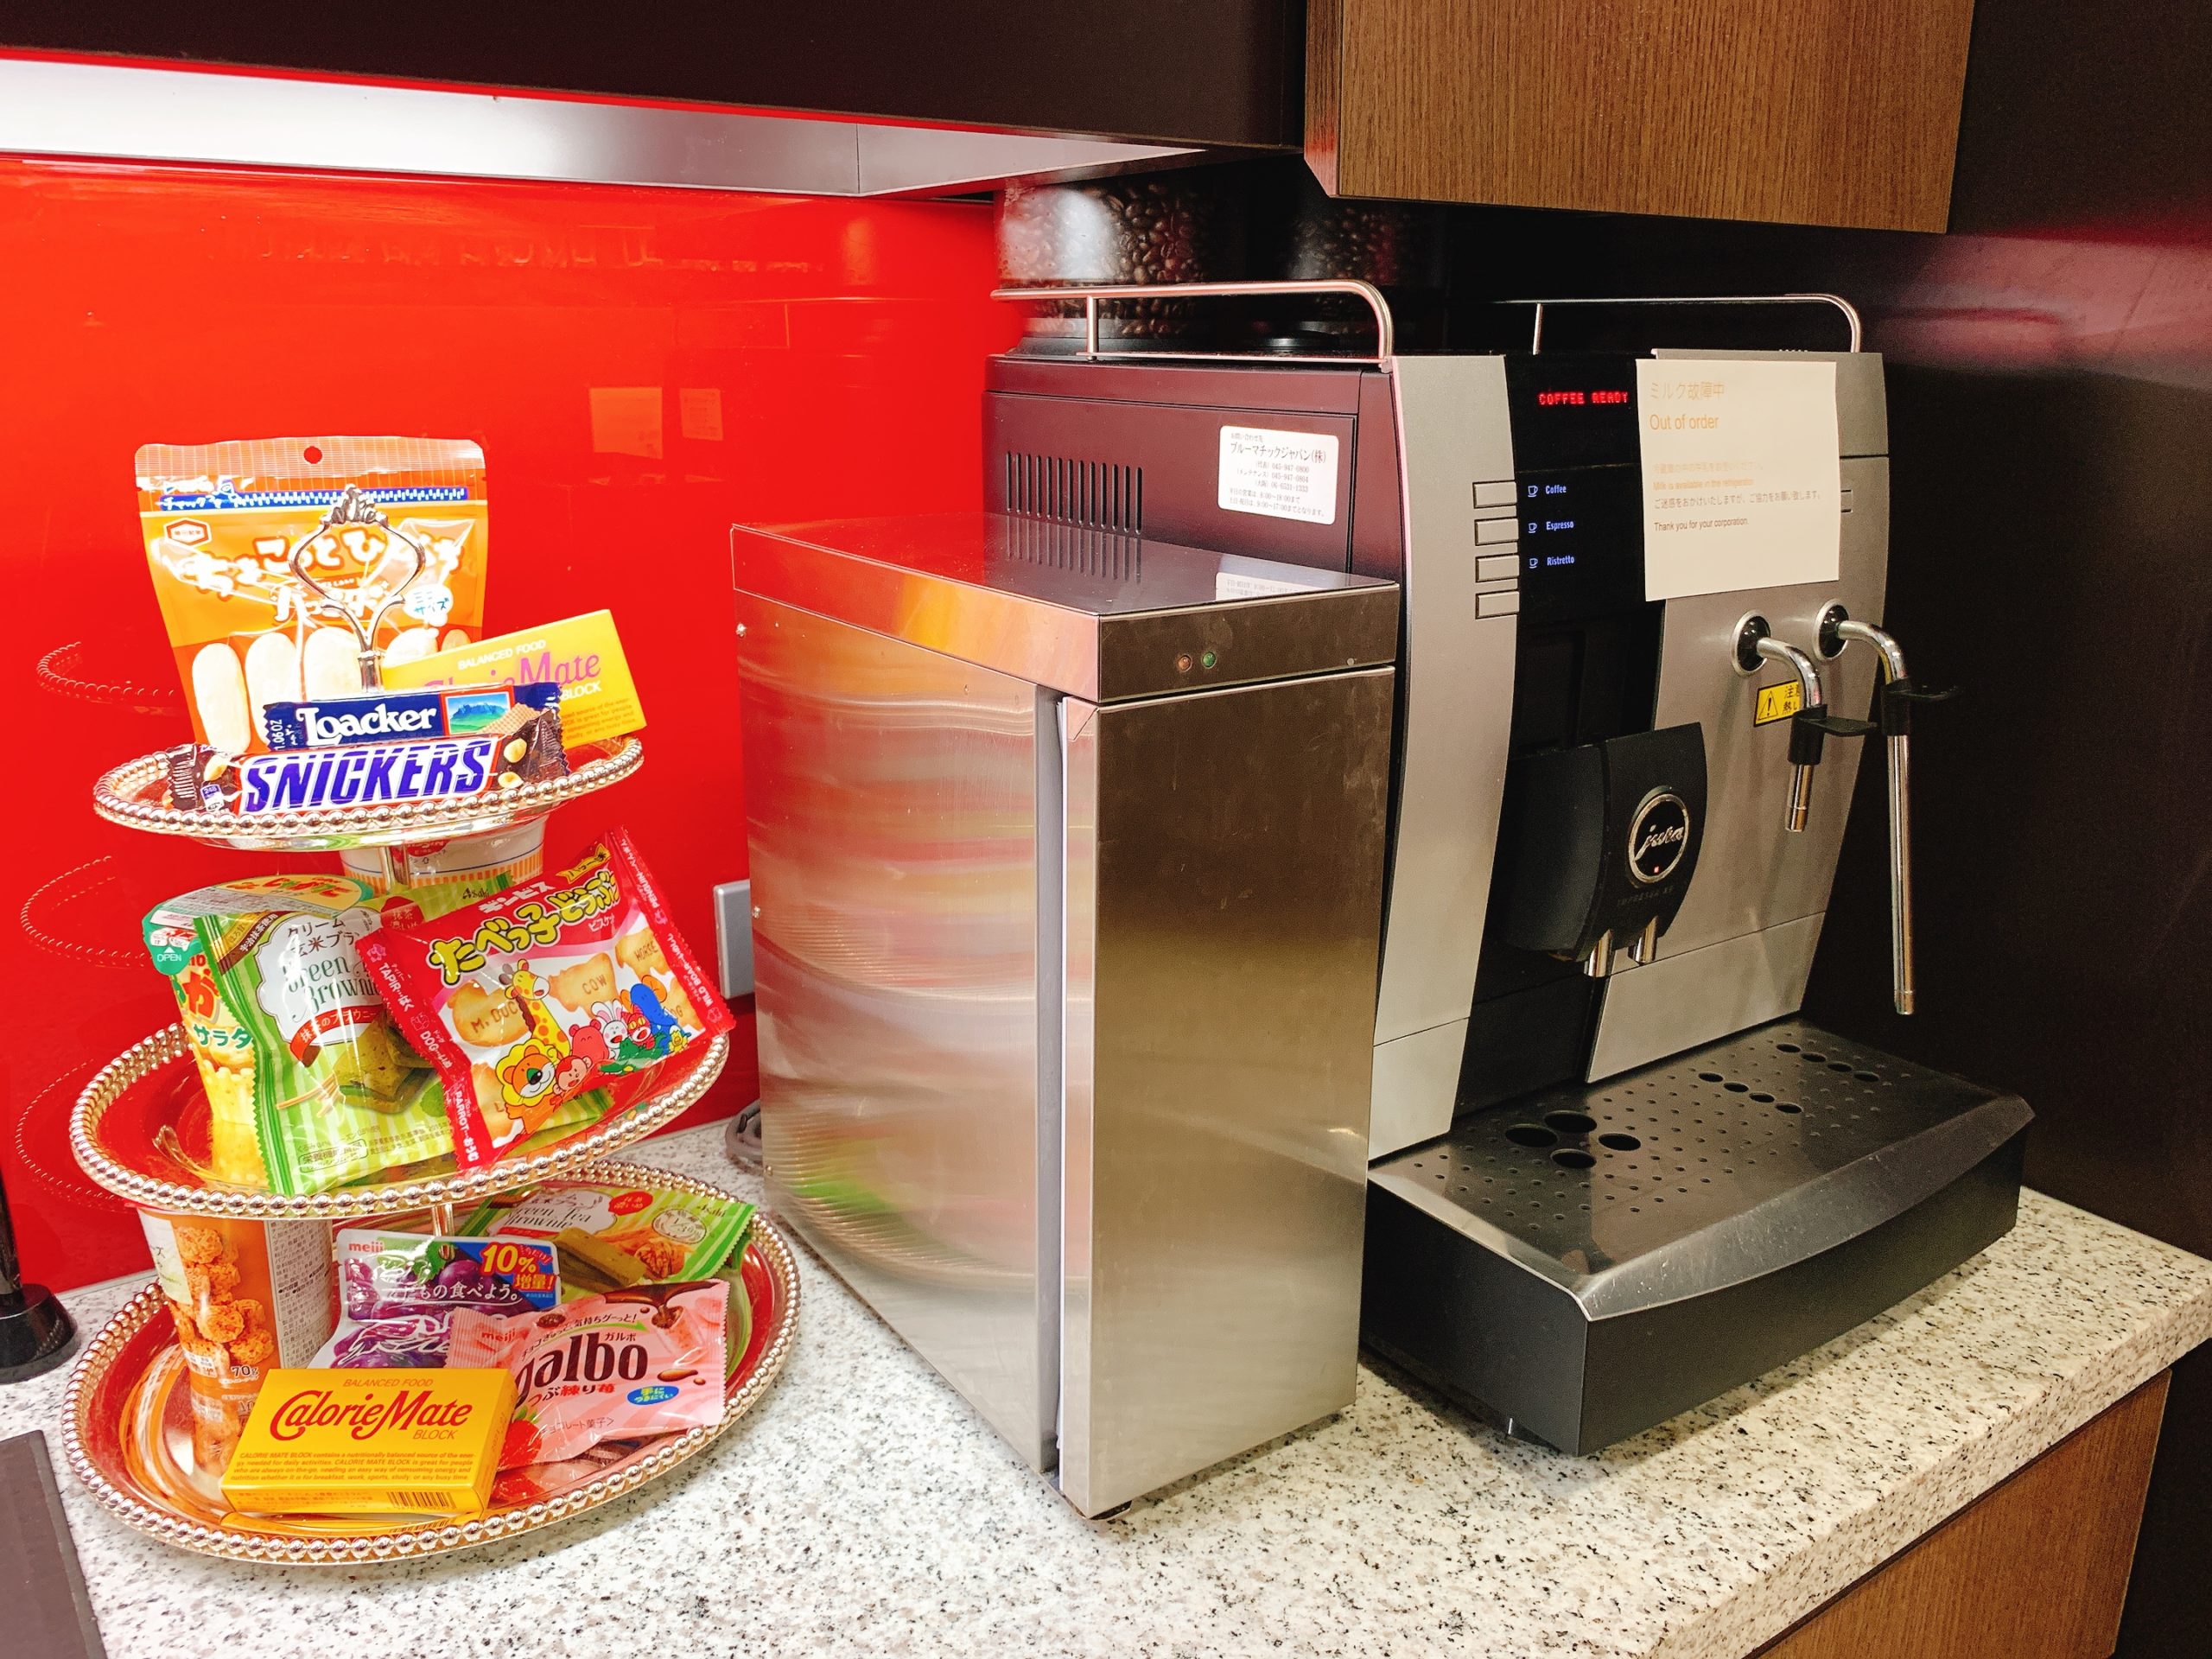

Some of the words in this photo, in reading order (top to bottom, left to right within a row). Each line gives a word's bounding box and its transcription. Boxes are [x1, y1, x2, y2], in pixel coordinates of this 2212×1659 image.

[1538, 391, 1585, 406] COFFEE
[1591, 391, 1629, 404] READY
[1649, 381, 1725, 401] ミルク故障中
[1649, 414, 1671, 430] Out
[1674, 413, 1686, 429] of
[1688, 414, 1719, 429] order
[1545, 485, 1567, 494] Coffee
[1546, 521, 1574, 531] Espresso
[1654, 522, 1674, 532] Thank
[1675, 522, 1688, 532] you
[1688, 520, 1698, 530] for
[1699, 520, 1713, 531] your
[1547, 555, 1575, 566] Ristretto
[457, 648, 512, 671] BALANCED
[516, 639, 546, 655] FOOD
[560, 680, 603, 702] BLOCK
[296, 702, 438, 749] Loacker
[245, 740, 493, 813] SNICKERS
[1634, 823, 1685, 861] jura
[478, 881, 556, 914] ギンビス
[156, 953, 182, 962] OPEN
[633, 940, 659, 962] HORSE
[582, 974, 609, 995] COW
[490, 1001, 518, 1024] DUC
[348, 1241, 385, 1254] meiji
[483, 1244, 537, 1274] 10%
[514, 1273, 555, 1291] 増量!
[481, 1328, 518, 1343] meiji
[604, 1332, 637, 1343] ガルボ
[231, 1365, 259, 1377] 70g
[515, 1332, 649, 1410] galbo
[342, 1378, 400, 1388] BALANCED
[403, 1378, 434, 1388] FOOD
[527, 1382, 616, 1408] つぶ練り苺
[412, 1429, 458, 1440] BLOCK
